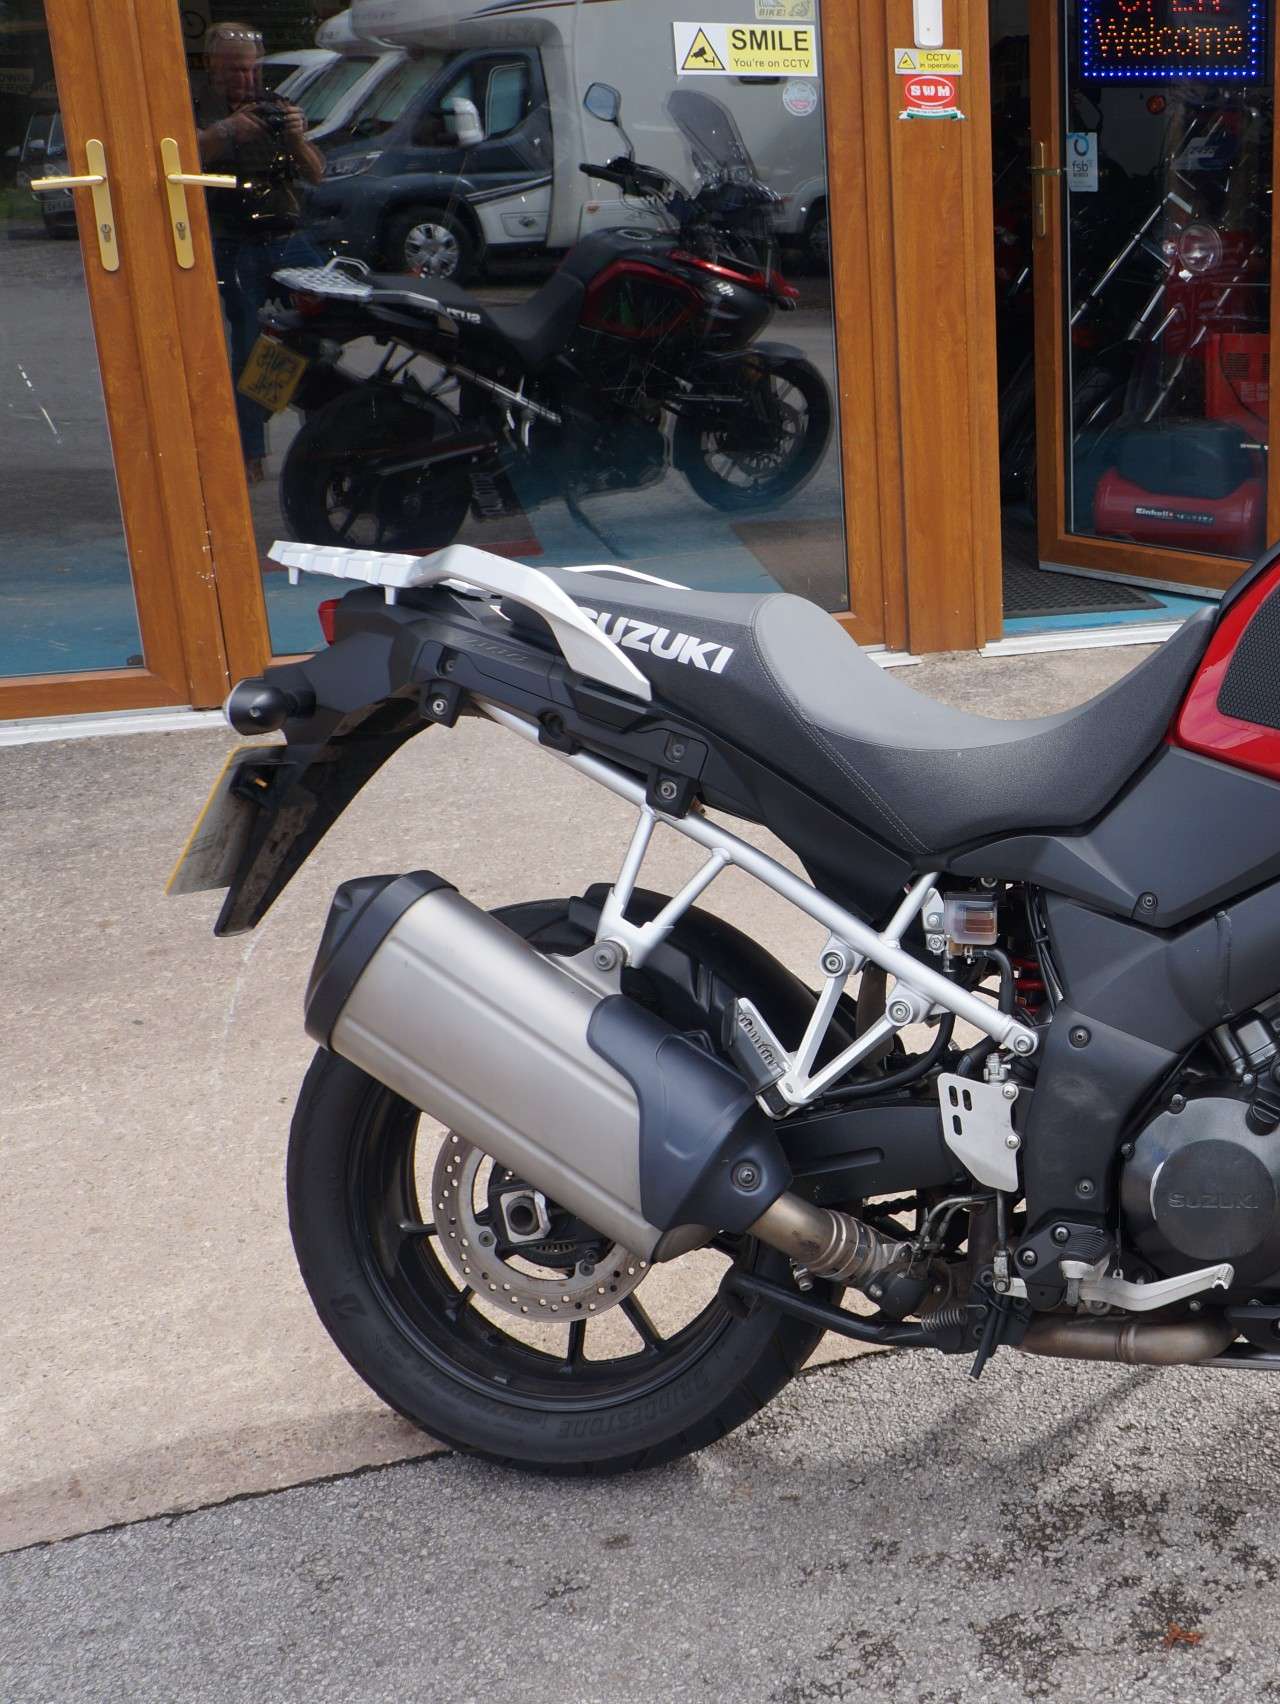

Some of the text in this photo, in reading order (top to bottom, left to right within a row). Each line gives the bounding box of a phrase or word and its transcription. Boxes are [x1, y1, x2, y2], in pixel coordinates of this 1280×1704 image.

[731, 29, 809, 52] SMILE
[1095, 16, 1243, 57] Welcome
[926, 53, 952, 61] CCTV
[733, 58, 810, 69] You're on CCTV
[927, 63, 959, 71] operation
[910, 85, 951, 97] SWM
[1072, 159, 1089, 173] fsb
[1136, 507, 1170, 518] Einhell
[1167, 1192, 1259, 1209] SUZUKI
